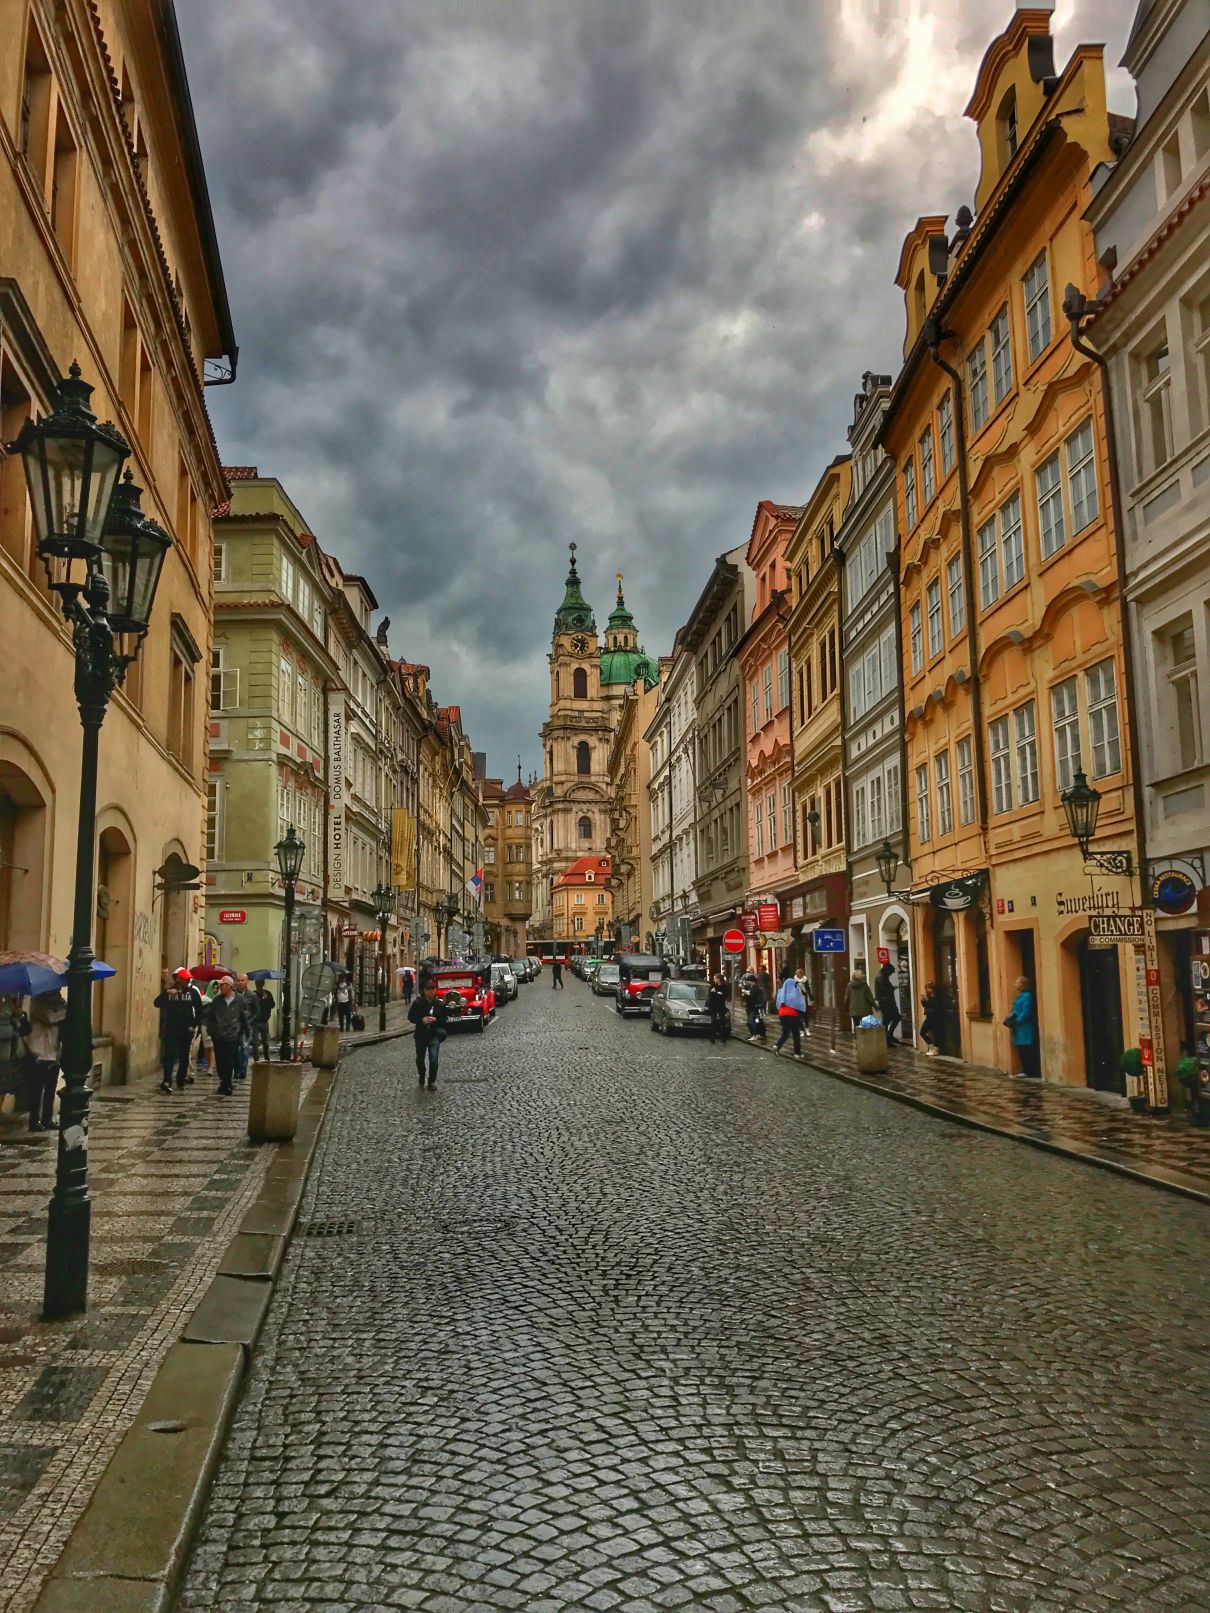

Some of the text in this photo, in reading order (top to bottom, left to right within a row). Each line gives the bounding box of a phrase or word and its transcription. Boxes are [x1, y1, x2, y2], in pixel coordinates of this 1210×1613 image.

[333, 712, 341, 890] DESIGN HOTEL DOMUS BALTHASAR
[1056, 886, 1119, 916] Suvenýry
[1091, 917, 1142, 935] CHANGE
[1145, 912, 1153, 926] NO
[1099, 936, 1145, 944] COMMISSION
[1147, 931, 1156, 966] LIMIT
